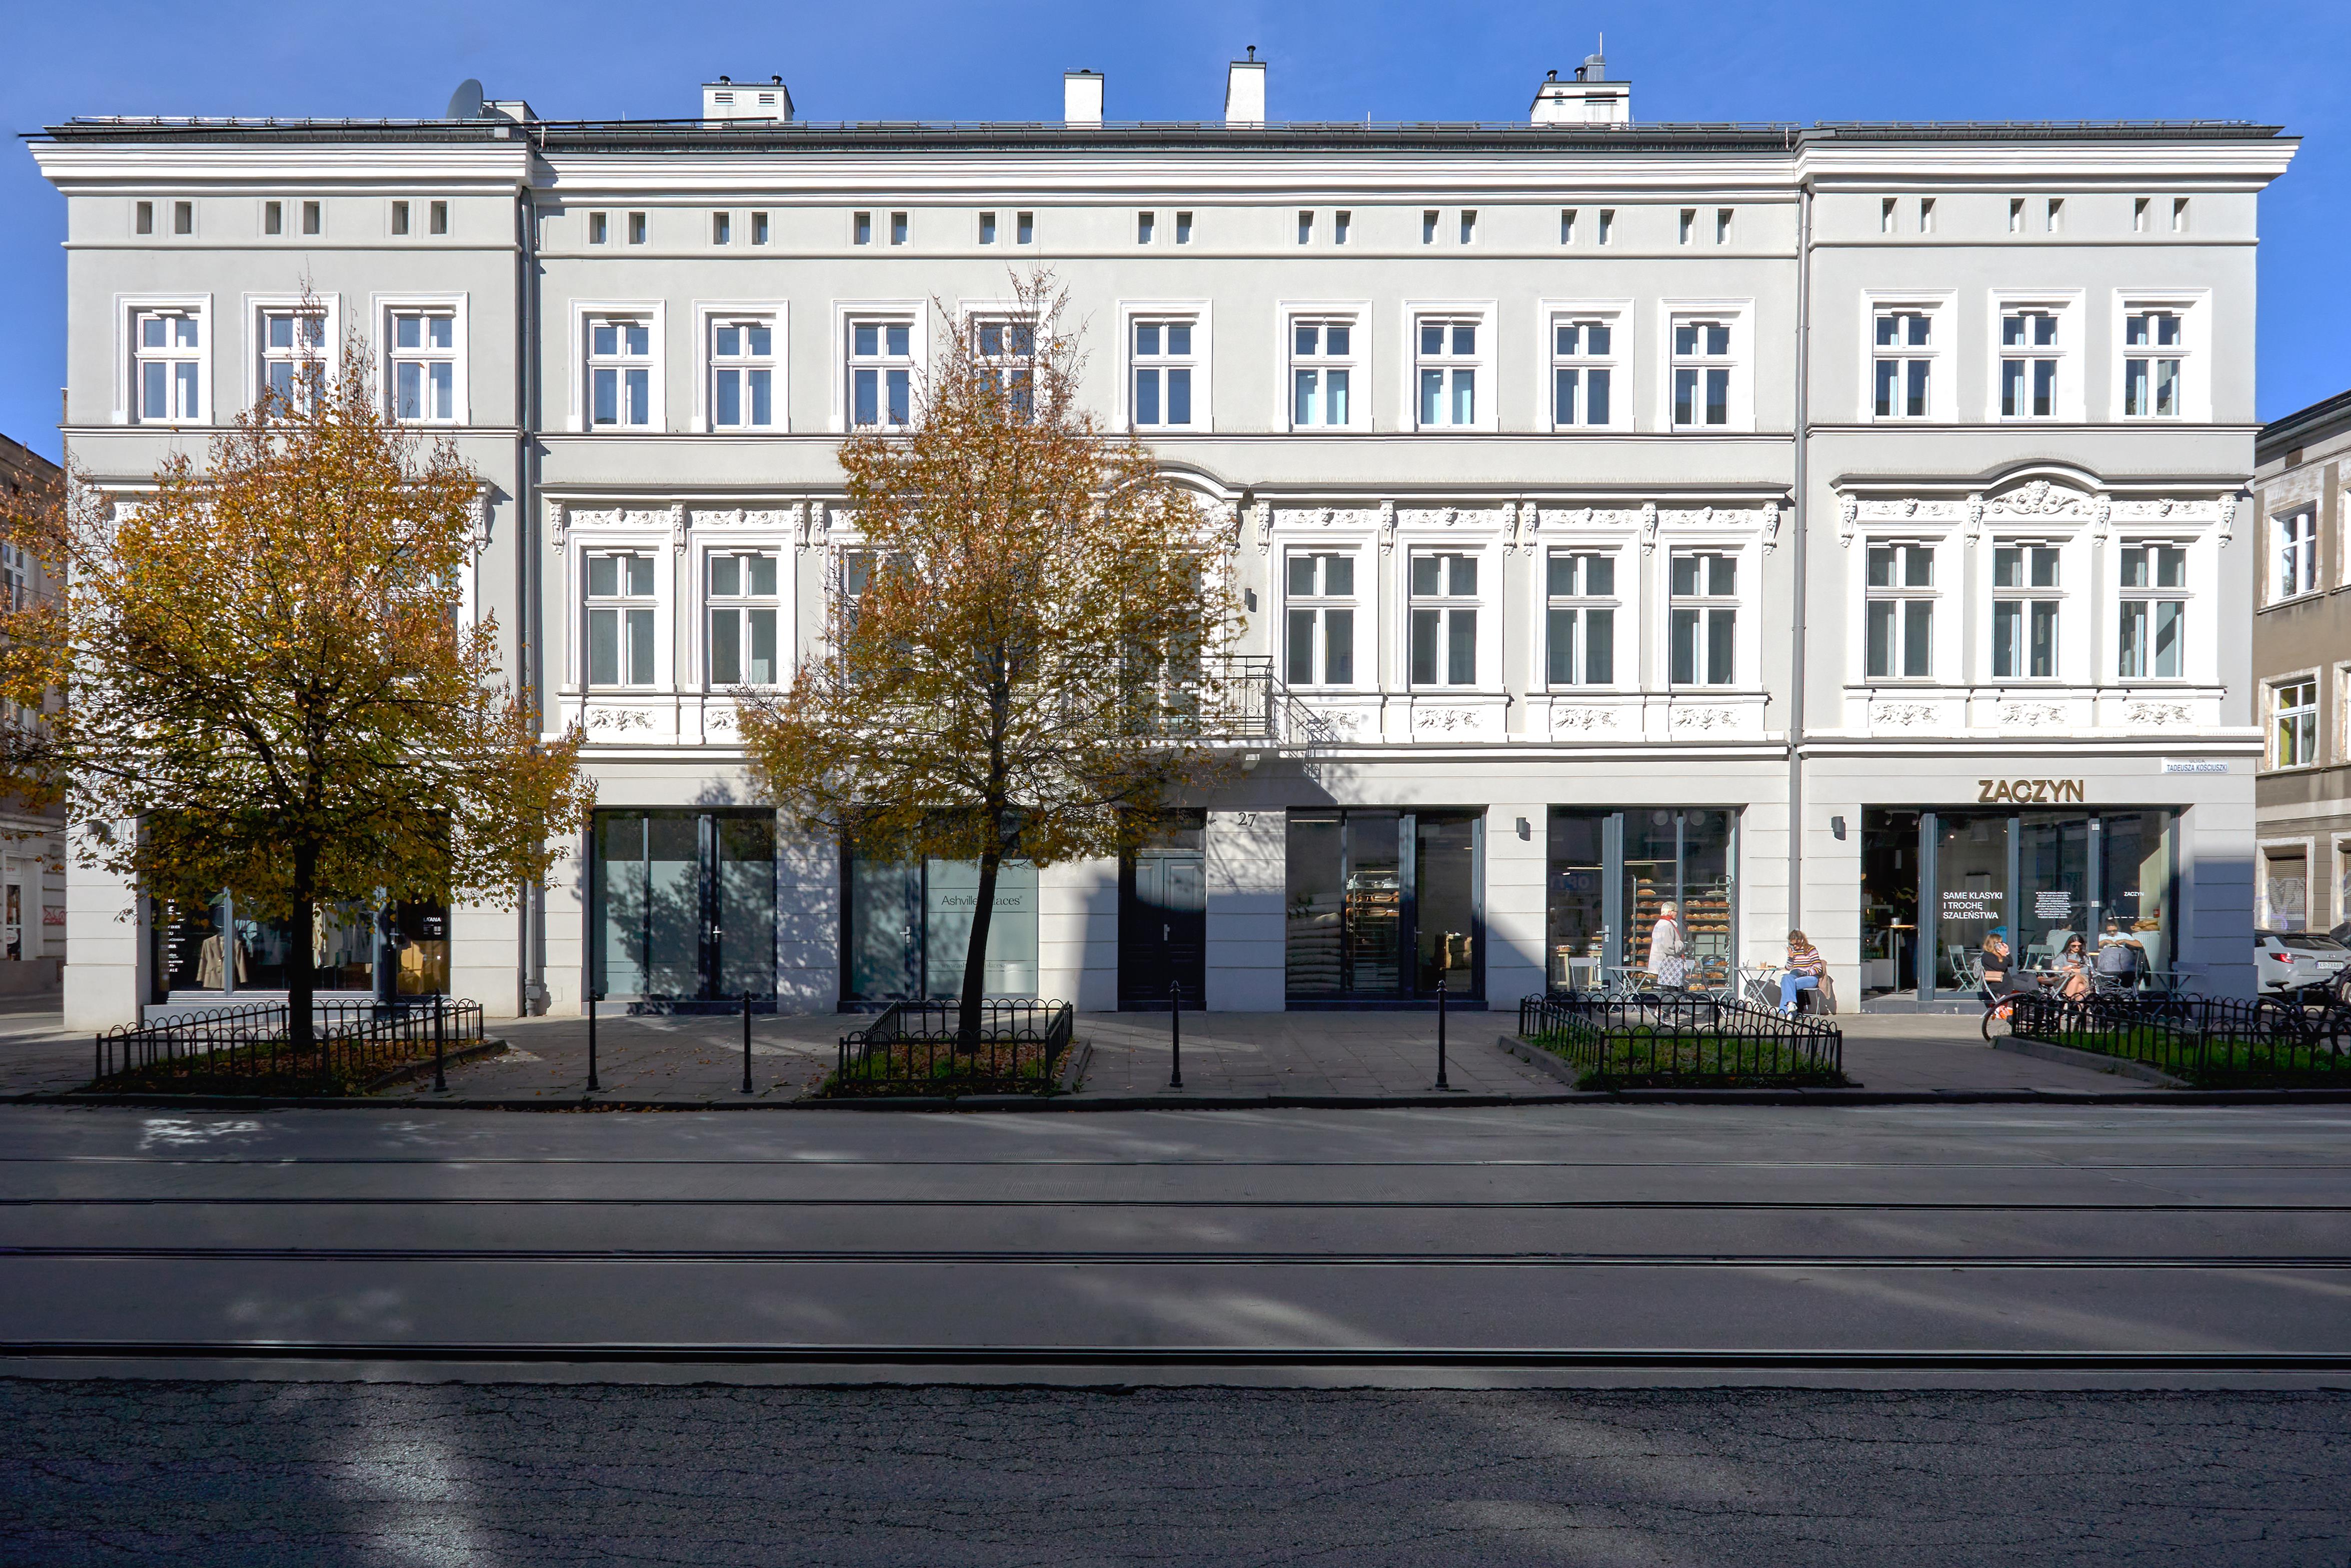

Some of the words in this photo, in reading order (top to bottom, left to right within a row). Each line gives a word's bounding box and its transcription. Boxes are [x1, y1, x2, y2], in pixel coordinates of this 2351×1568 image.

[1978, 779, 2083, 803] ZACZYN
[1238, 812, 1257, 827] 27
[941, 895, 978, 906] Ashville
[1948, 902, 1983, 911] TROCHĘ
[1943, 910, 1999, 919] SZALEŃSTWA
